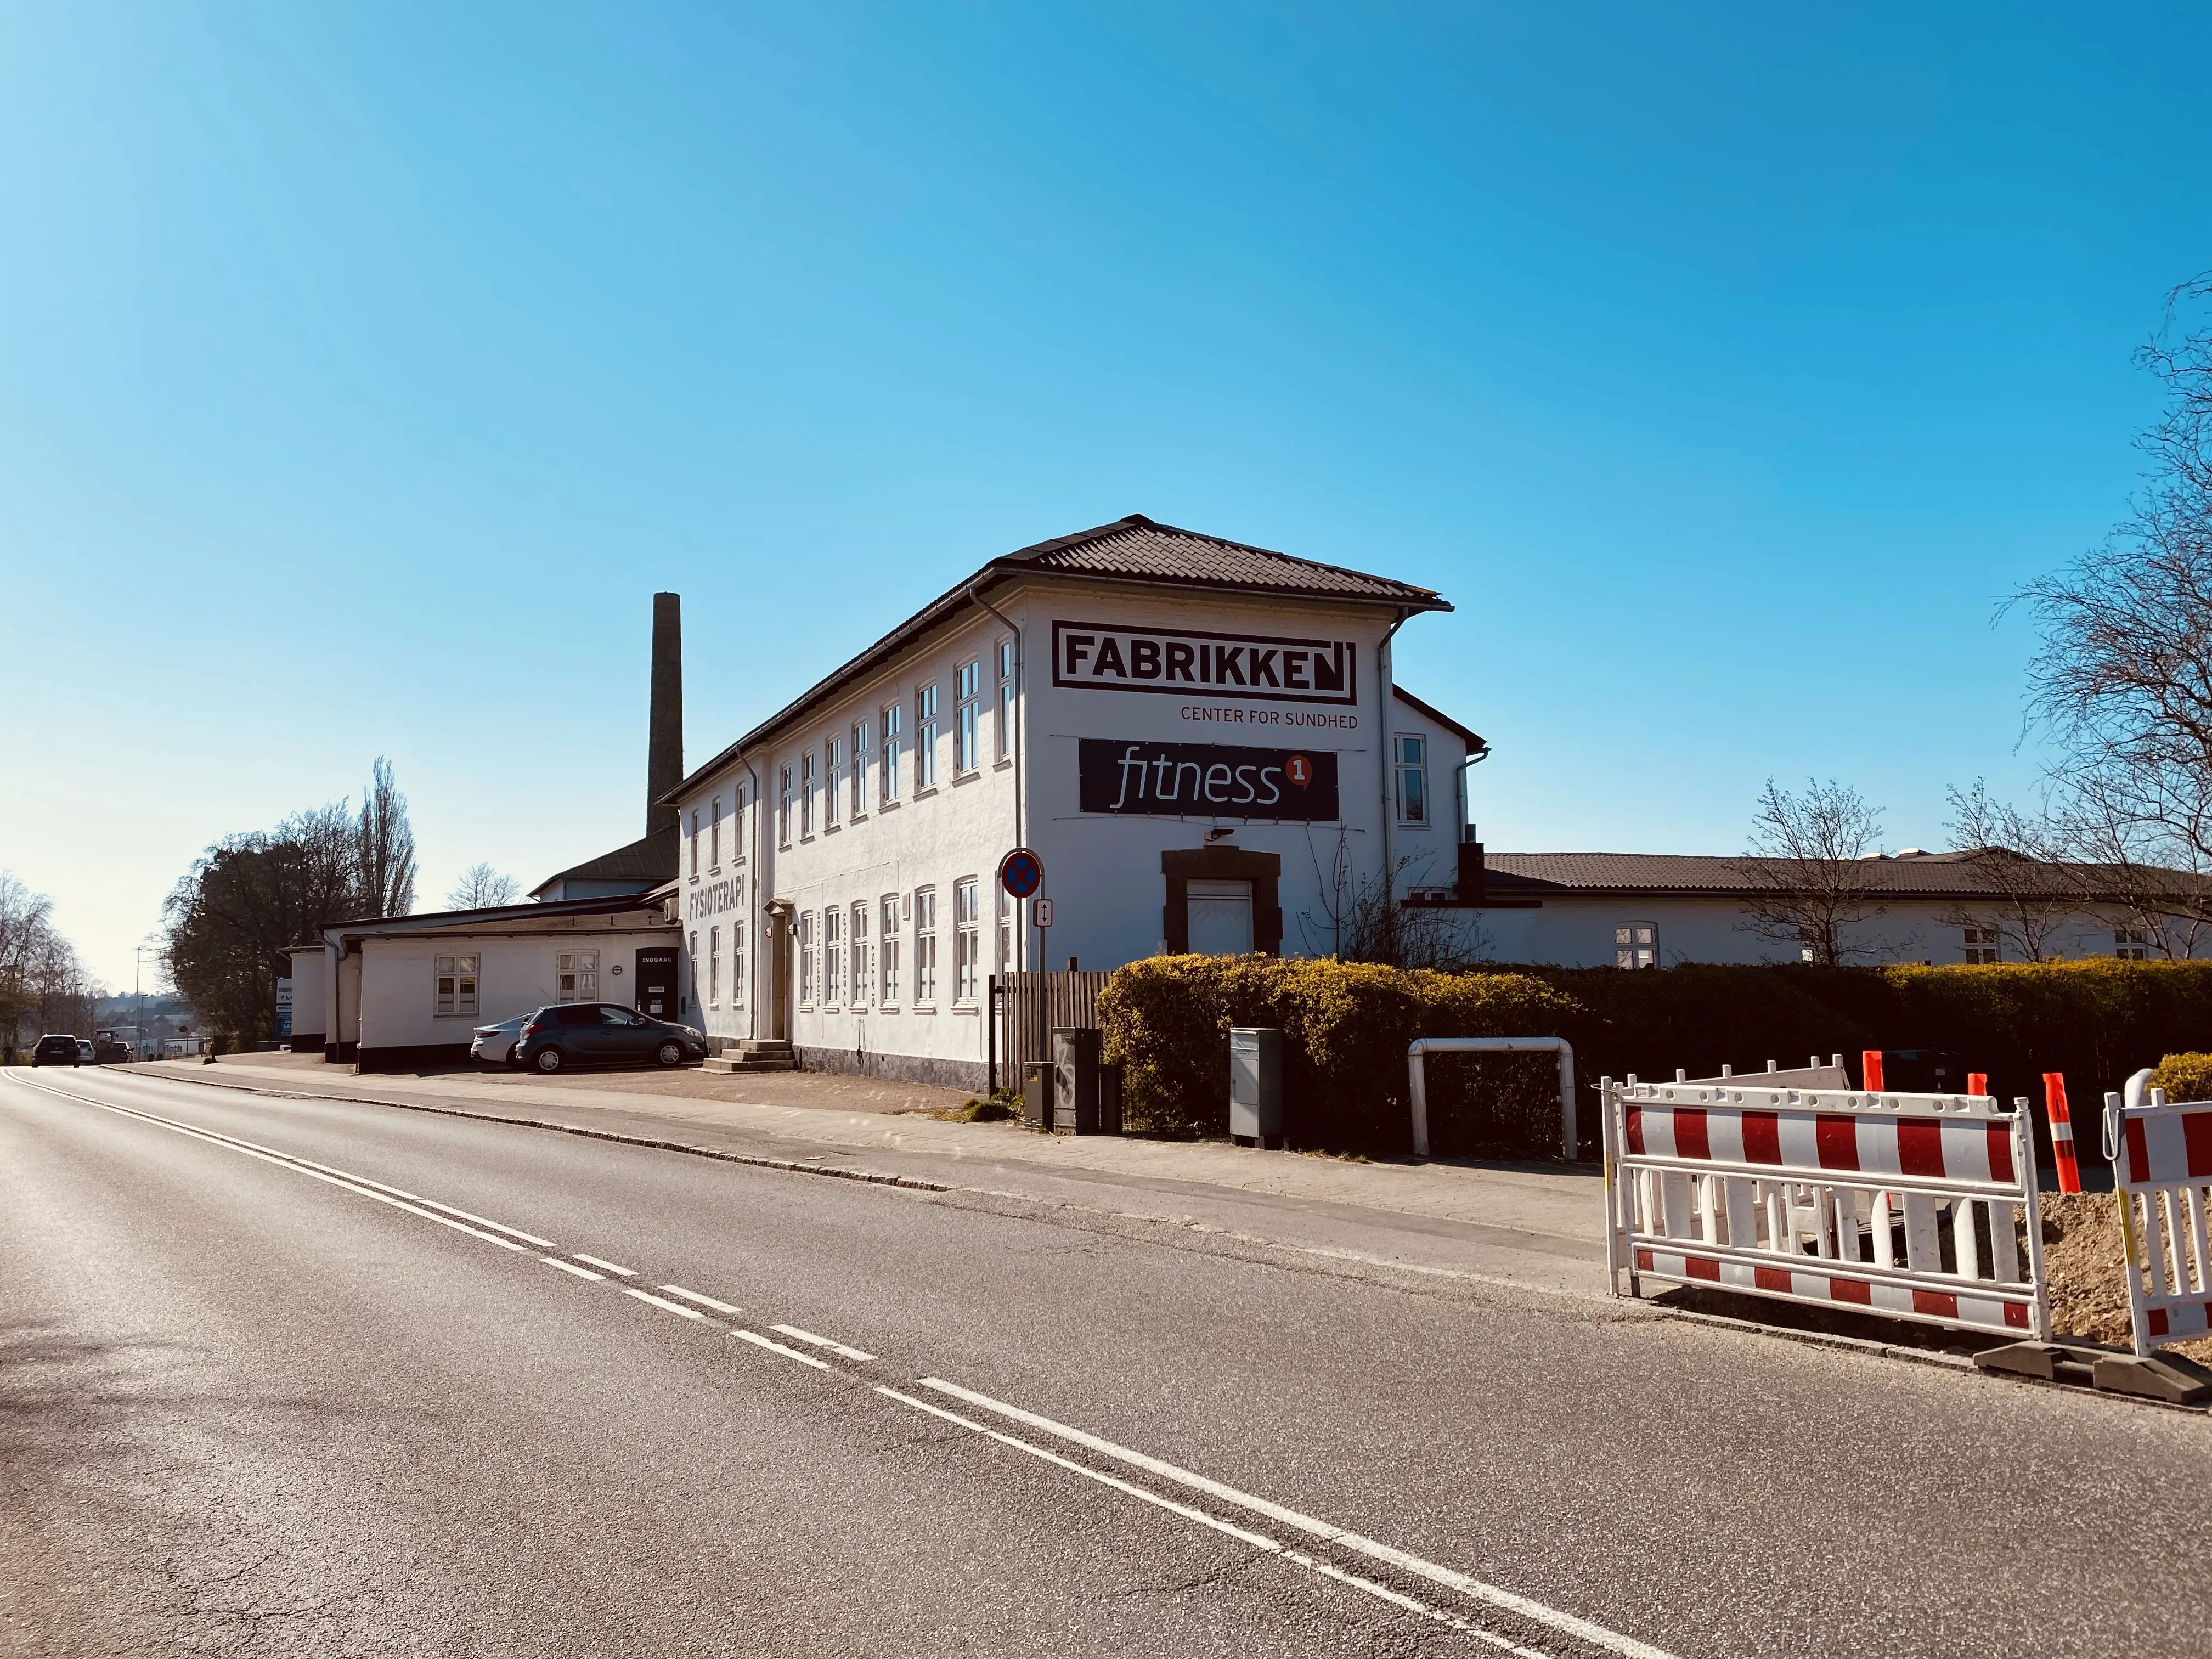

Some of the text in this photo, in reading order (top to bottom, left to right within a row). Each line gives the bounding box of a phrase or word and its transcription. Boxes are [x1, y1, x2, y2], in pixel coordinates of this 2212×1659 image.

[1065, 634, 1345, 692] FABRIKKEN
[1181, 706, 1358, 729] CENTER FOR SUNDHED
[1109, 746, 1306, 809] fitness 1
[690, 873, 744, 922] FYSIOTERAPI
